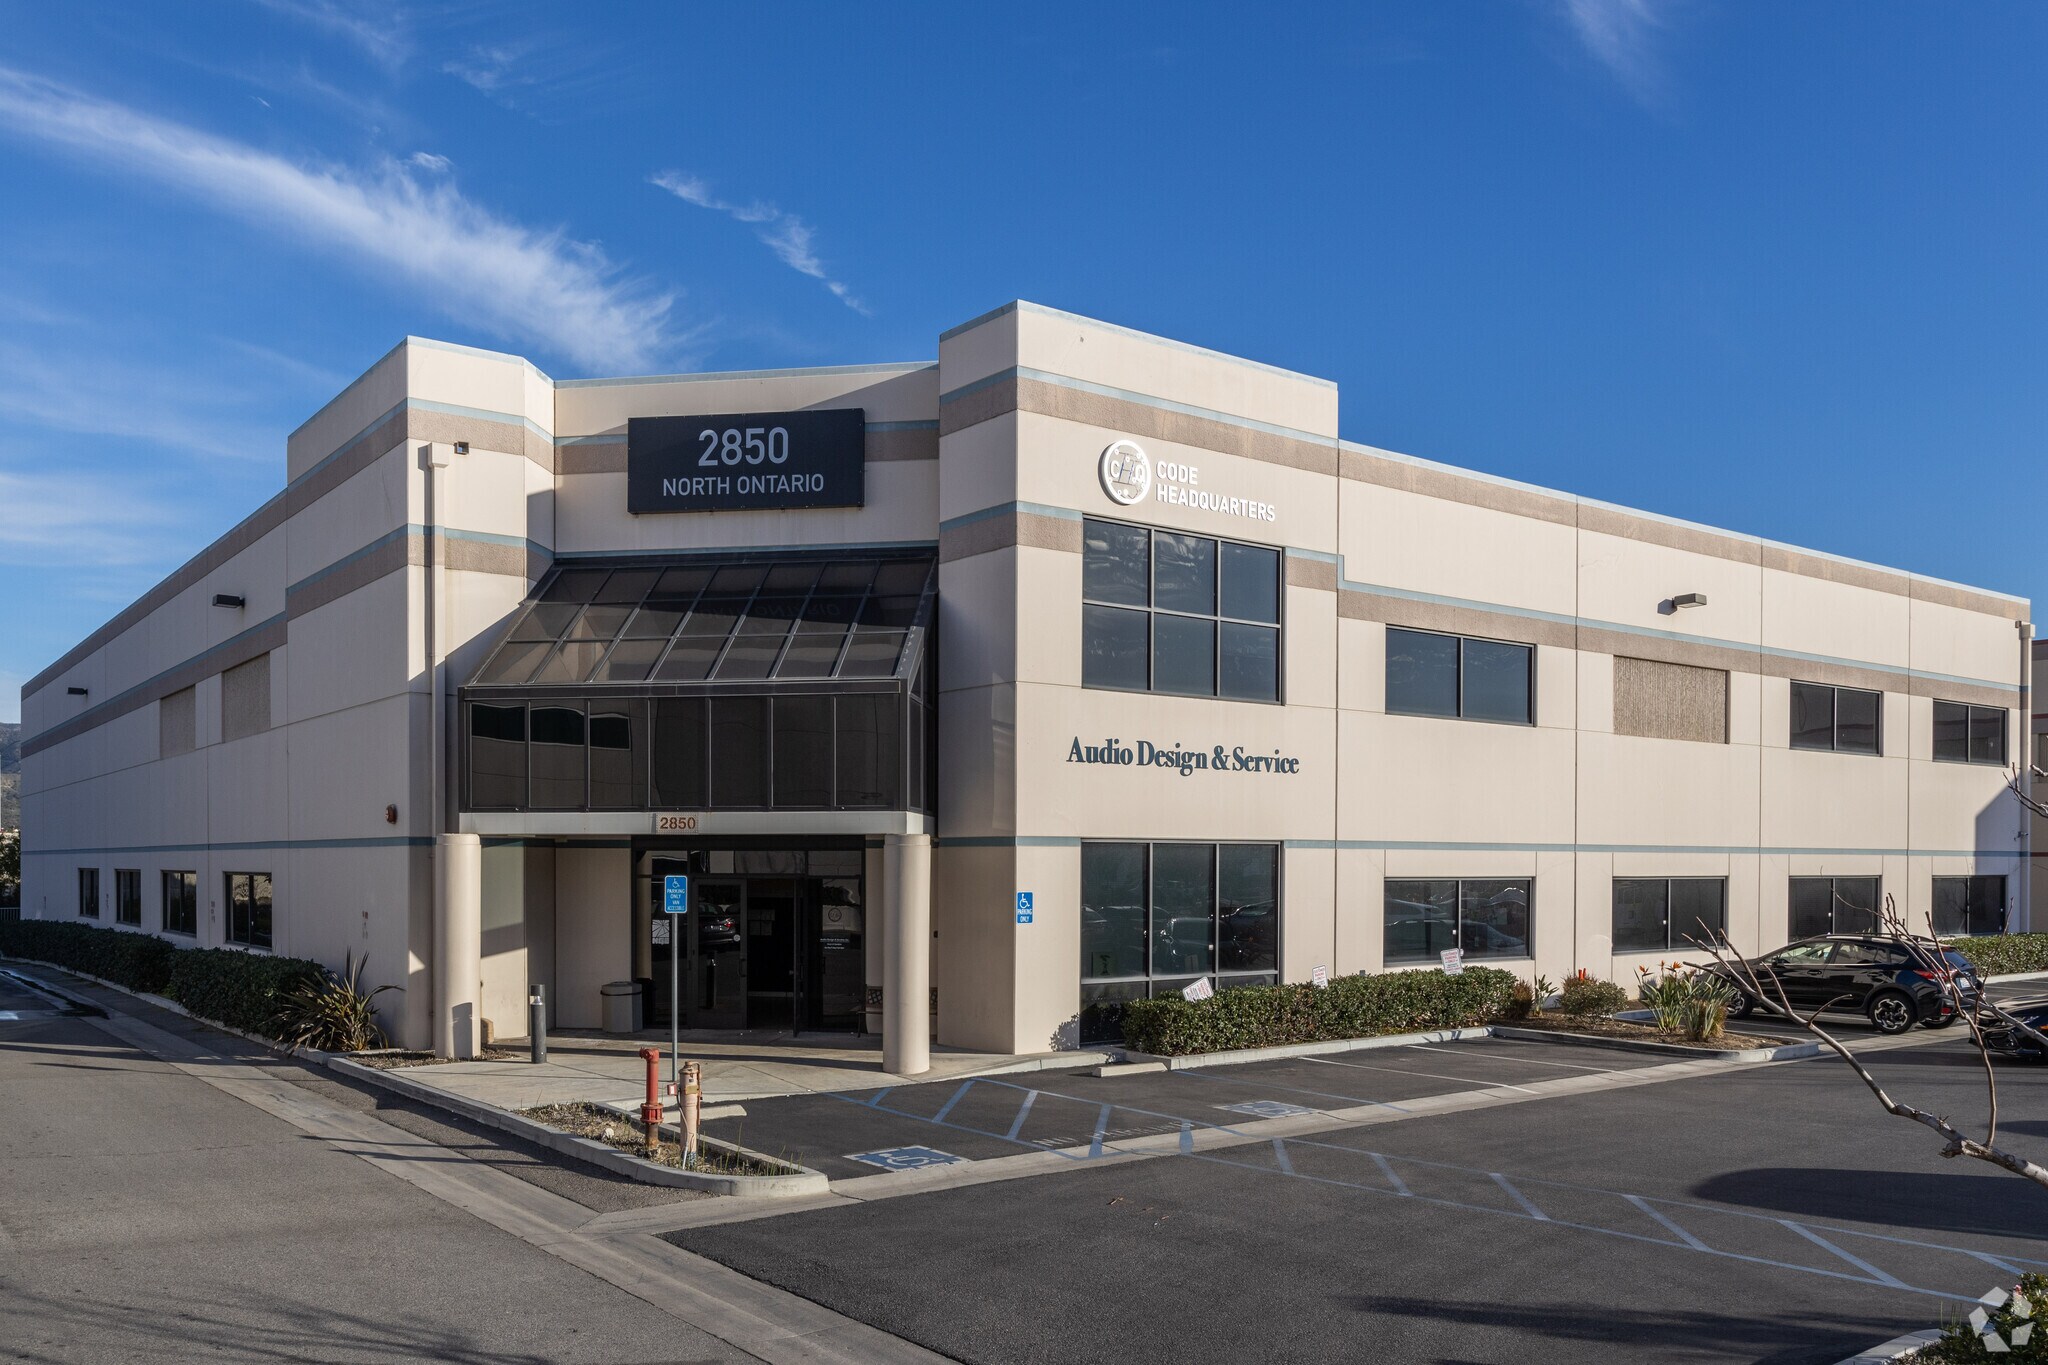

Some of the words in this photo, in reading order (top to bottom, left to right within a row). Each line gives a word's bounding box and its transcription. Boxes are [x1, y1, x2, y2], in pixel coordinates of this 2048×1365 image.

[698, 427, 789, 466] 2850
[663, 477, 730, 496] NORTH
[737, 473, 824, 494] ONTARIO
[1156, 461, 1198, 485] CODE
[1156, 484, 1276, 522] HEADQUARTERS
[1066, 736, 1133, 765] Audio
[1136, 740, 1208, 776] Design
[1211, 745, 1230, 770] &
[1232, 746, 1299, 774] Service
[660, 816, 696, 829] 2850
